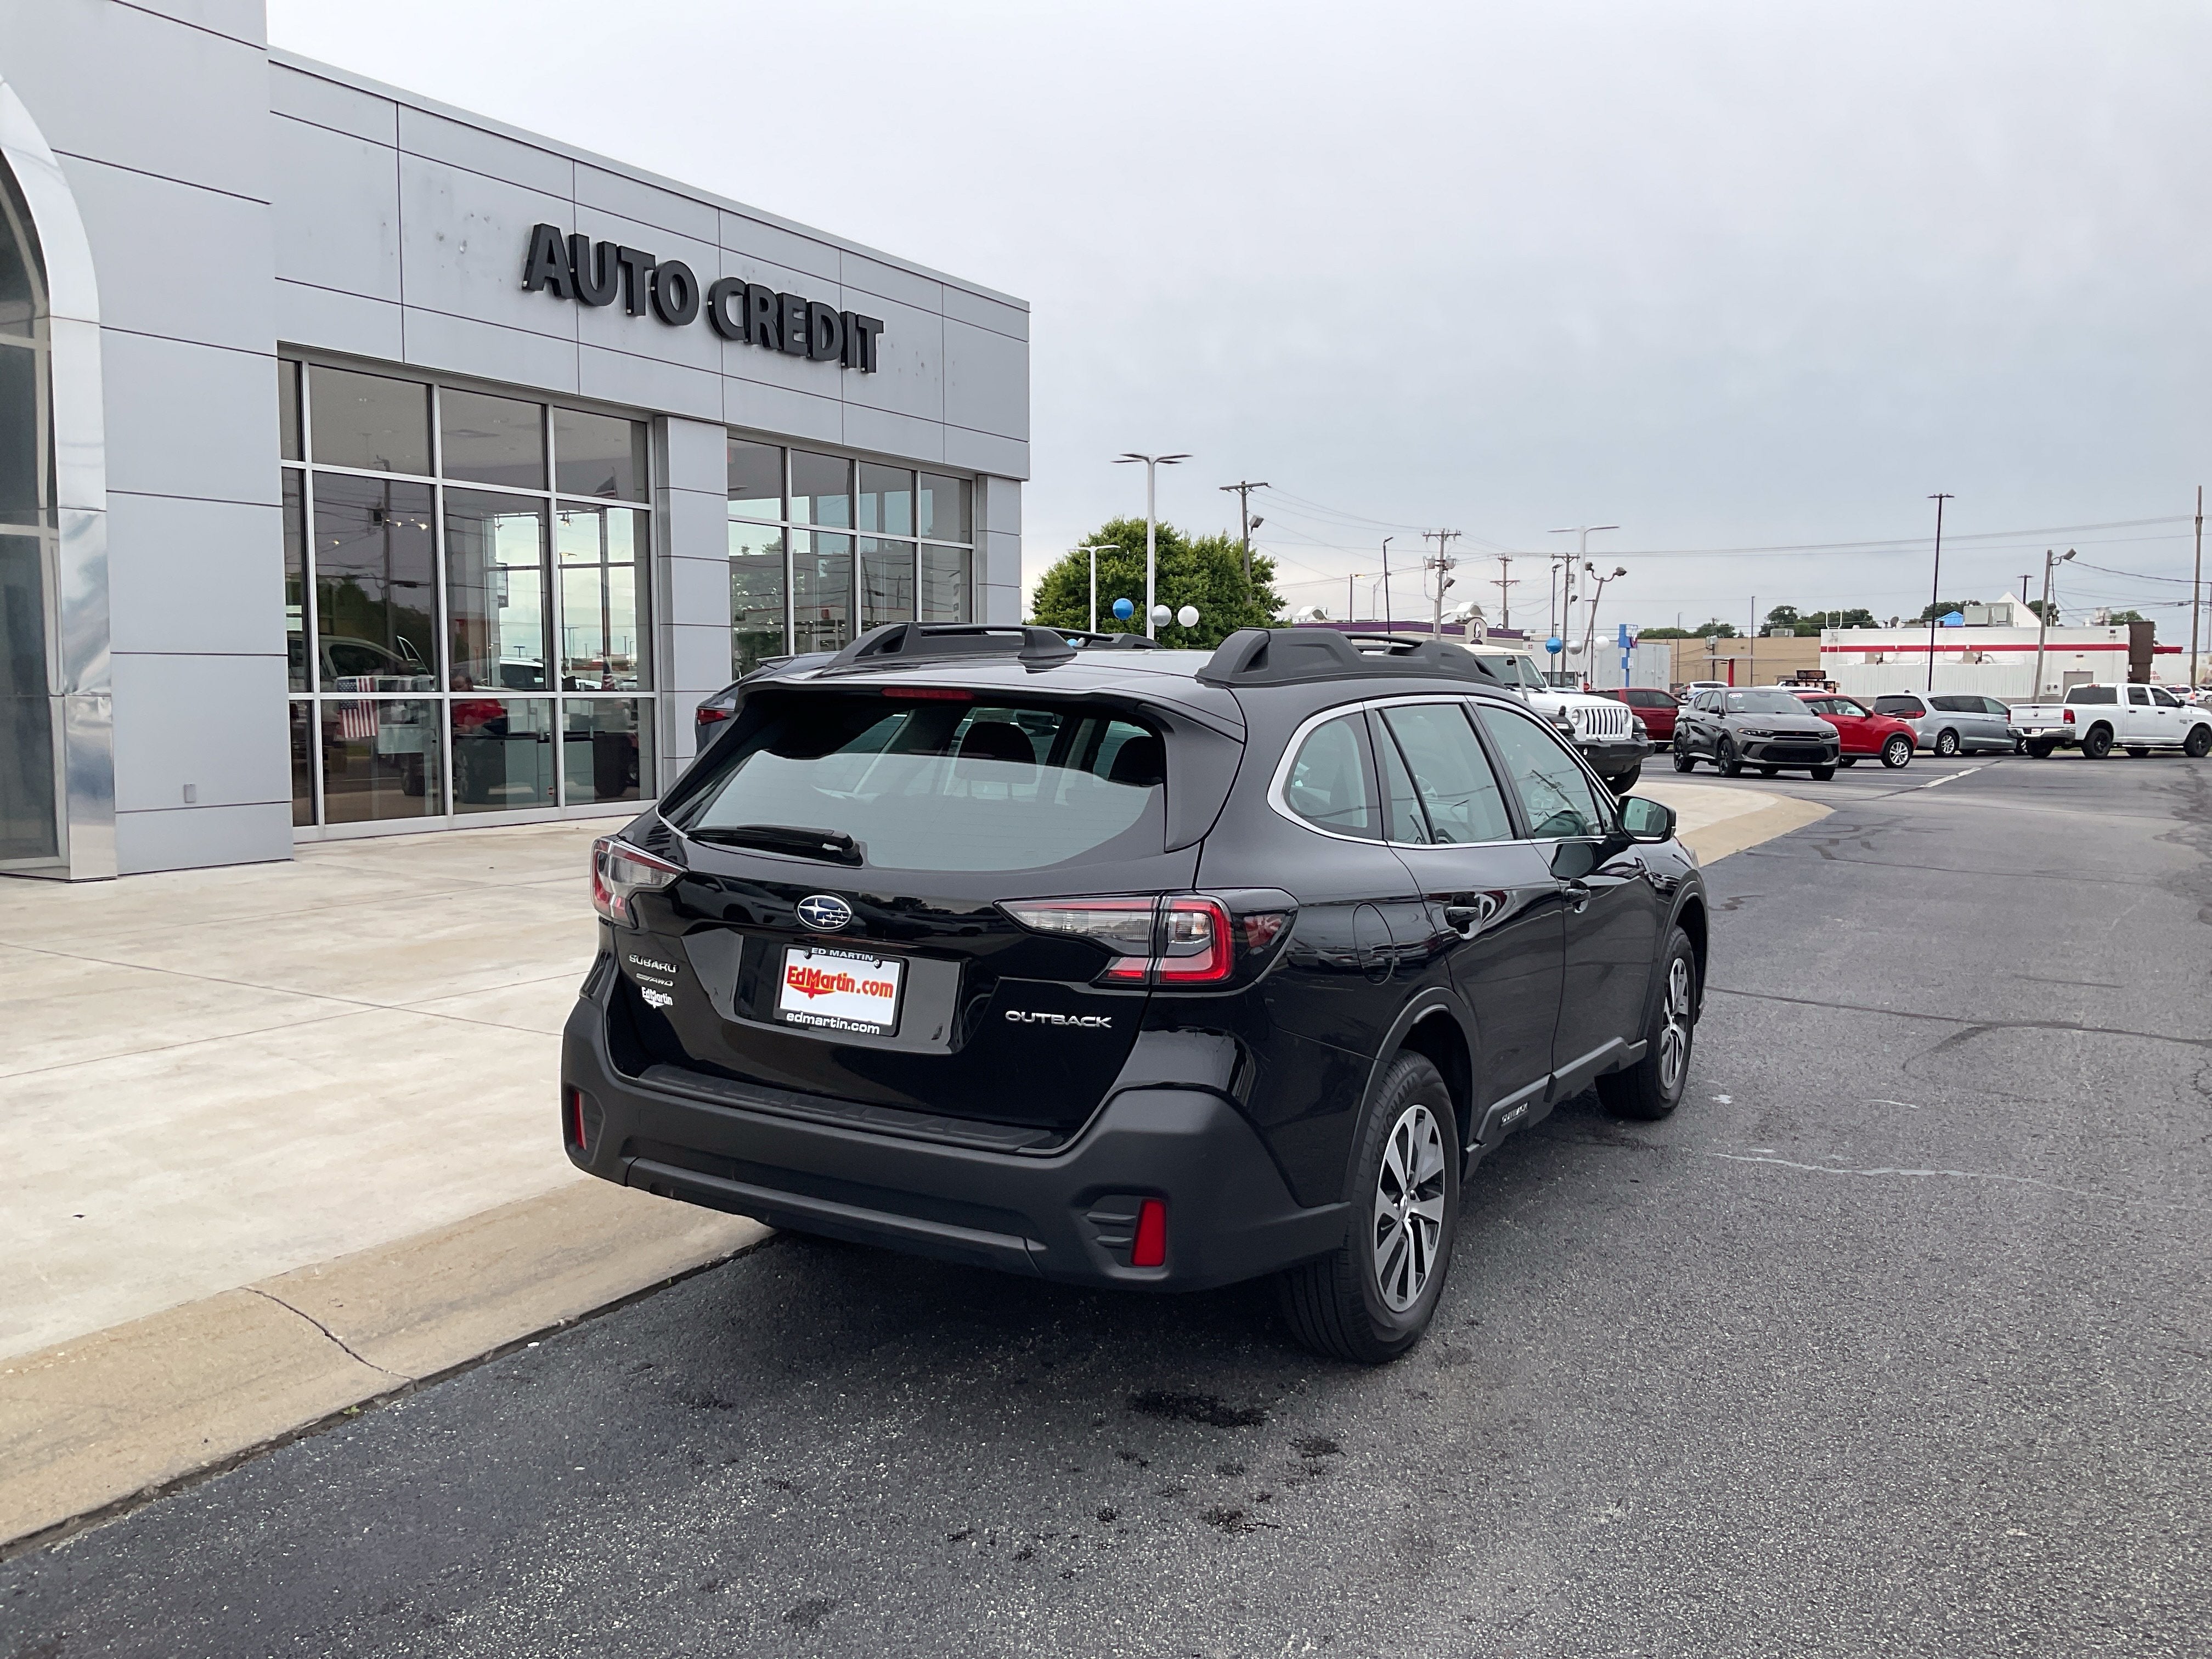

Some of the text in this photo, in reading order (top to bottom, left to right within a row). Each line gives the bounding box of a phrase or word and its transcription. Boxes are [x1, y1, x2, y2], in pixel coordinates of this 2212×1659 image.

[522, 223, 884, 374] AUTO CREDIT
[629, 953, 678, 973] SUBARU
[811, 947, 873, 961] ED MARTIN
[786, 965, 894, 998] EdMartin.com
[786, 1012, 880, 1035] edmartin.com
[1005, 1010, 1112, 1028] OUTBACK
